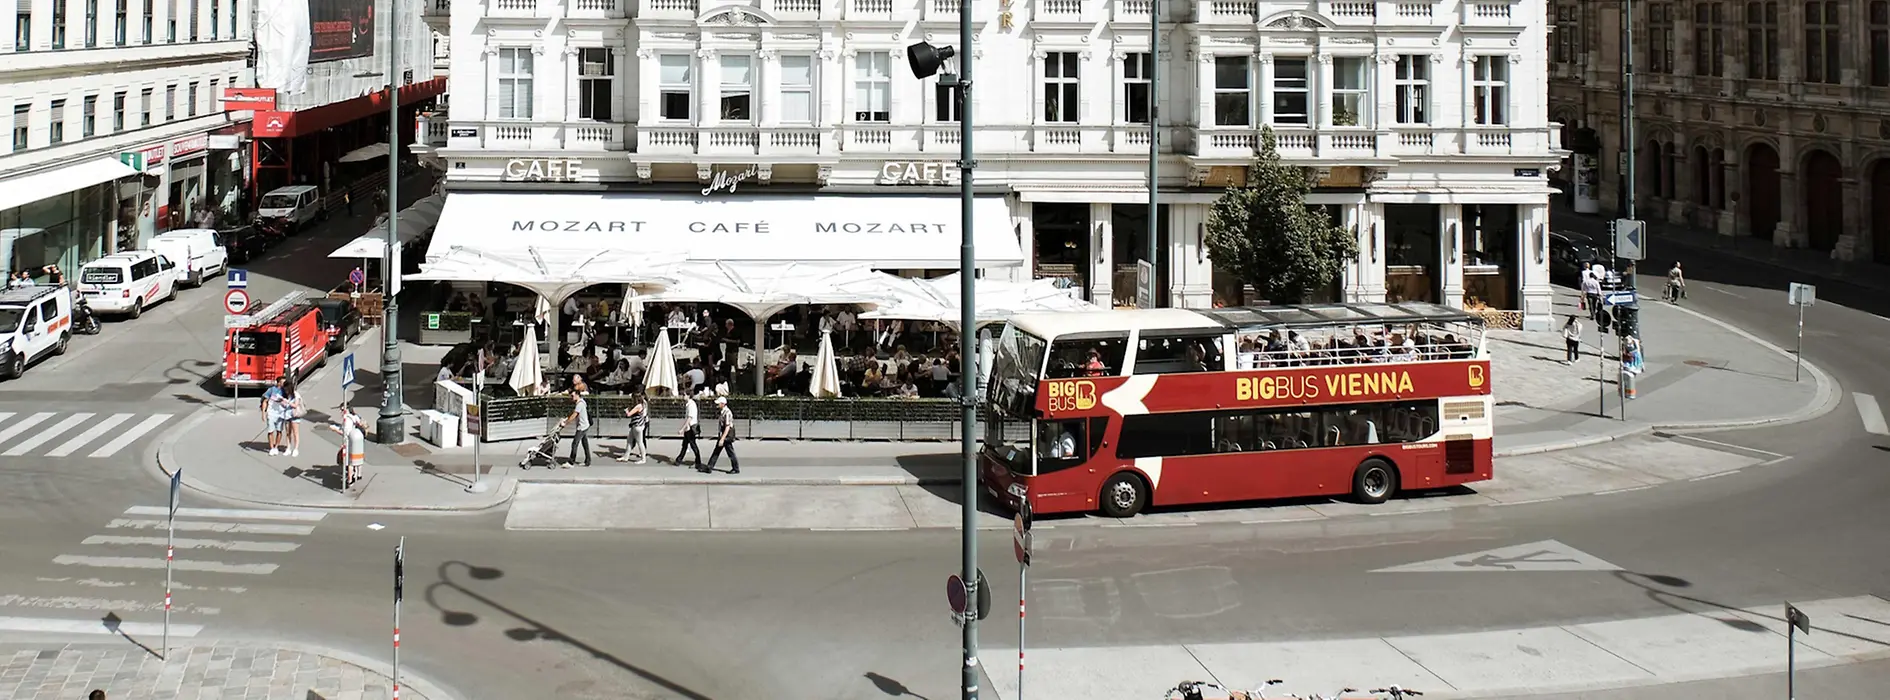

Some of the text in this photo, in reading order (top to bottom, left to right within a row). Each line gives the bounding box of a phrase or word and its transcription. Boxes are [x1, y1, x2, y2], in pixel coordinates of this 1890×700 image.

[701, 163, 757, 196] Mozart
[511, 219, 947, 234] MOZART CAFÉ MOZART
[1048, 380, 1075, 398] BIG
[1324, 370, 1415, 398] VIENNA
[1048, 397, 1076, 412] BUS
